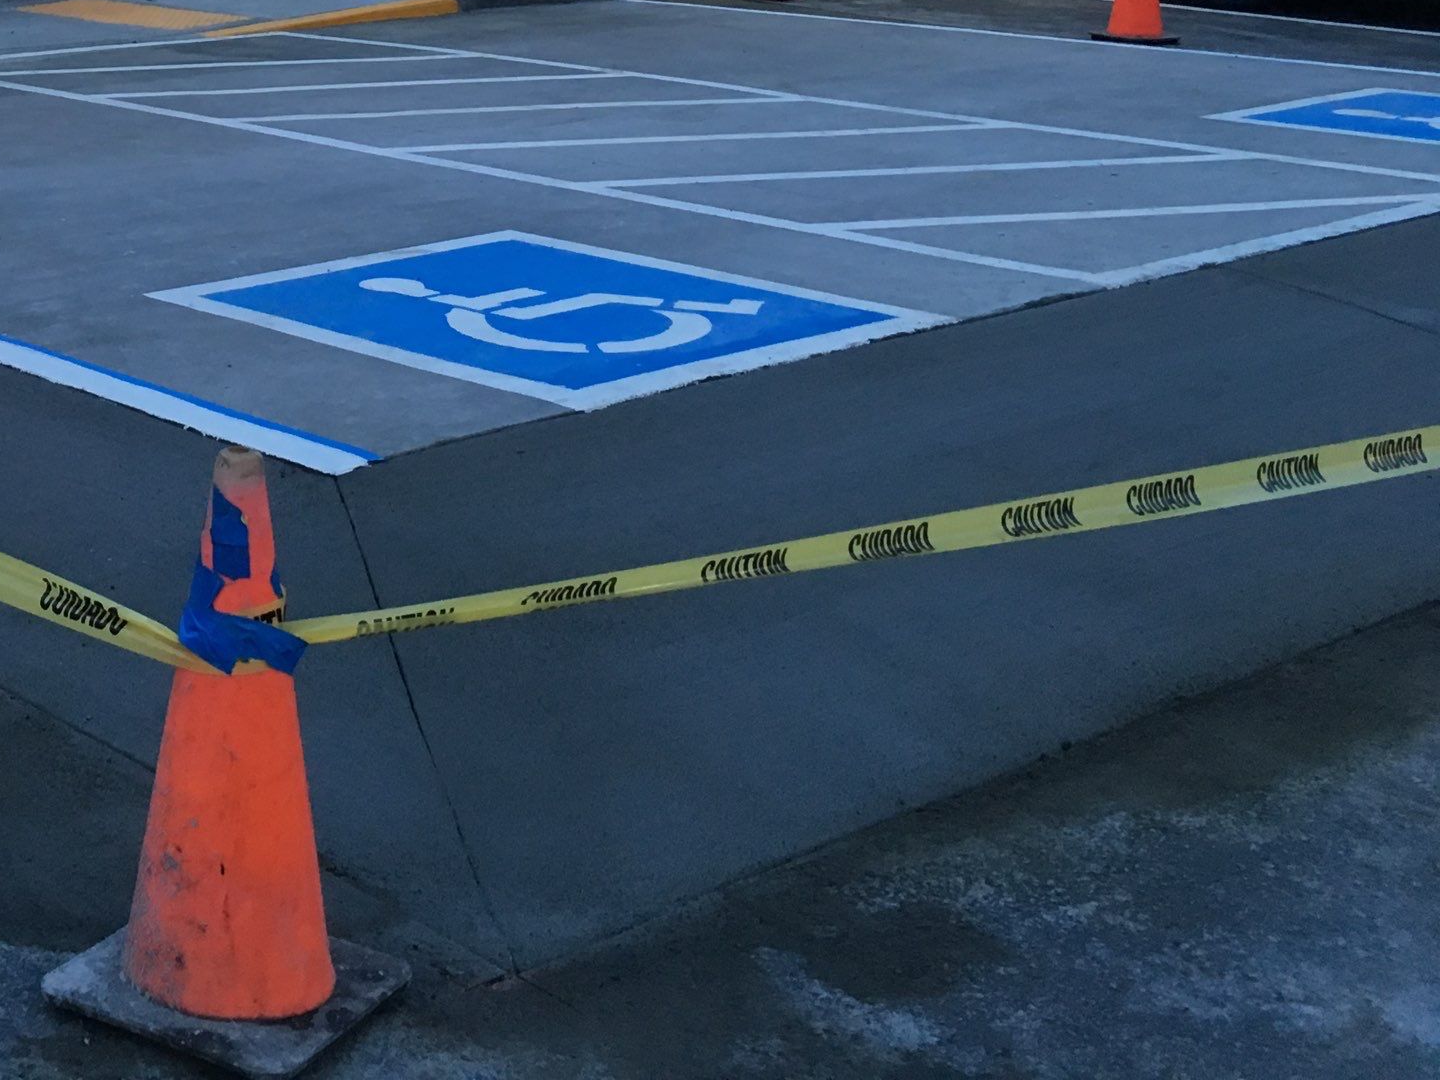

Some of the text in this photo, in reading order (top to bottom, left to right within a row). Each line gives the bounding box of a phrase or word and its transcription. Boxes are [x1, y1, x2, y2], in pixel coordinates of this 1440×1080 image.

[700, 547, 792, 583] CAUTION
[848, 521, 936, 562] CUIDADO
[1001, 496, 1084, 538] CAUTION
[1126, 474, 1203, 516] CUIDADO
[1256, 452, 1327, 494] CAUTION
[1363, 433, 1428, 473] CUIDADO
[39, 577, 129, 636] CUIDADO
